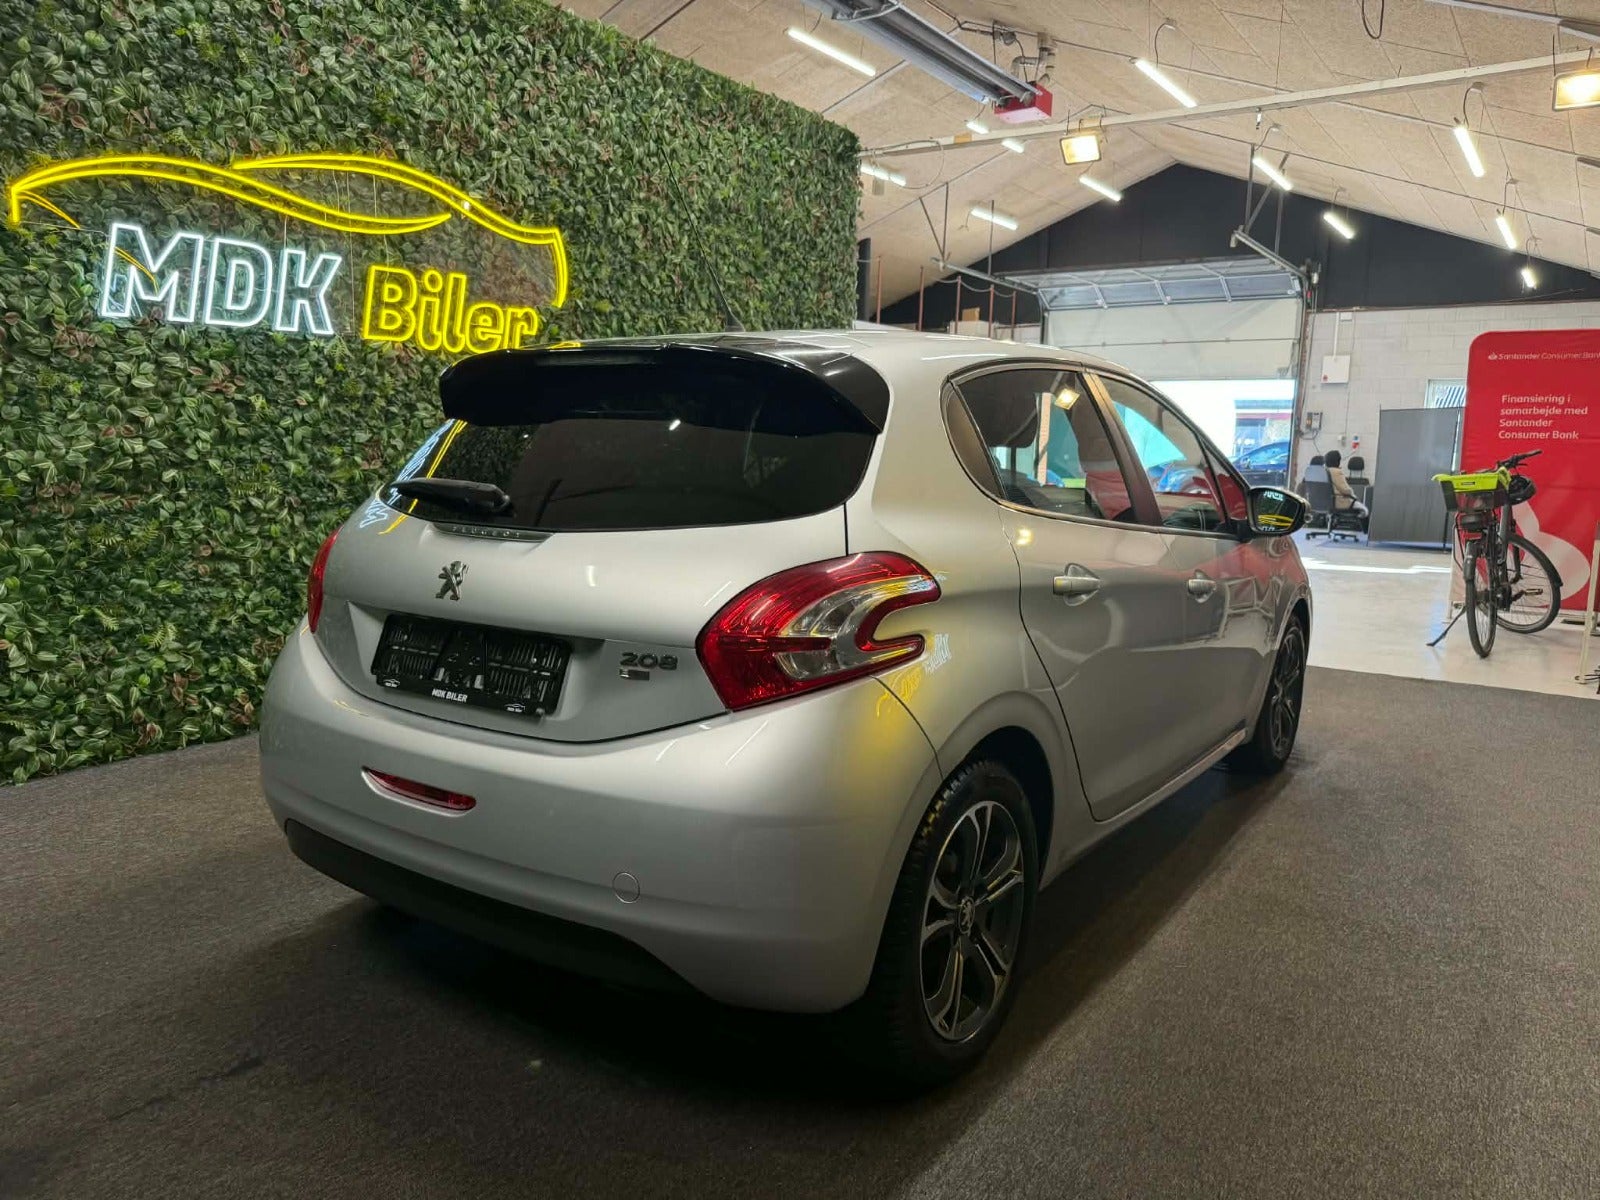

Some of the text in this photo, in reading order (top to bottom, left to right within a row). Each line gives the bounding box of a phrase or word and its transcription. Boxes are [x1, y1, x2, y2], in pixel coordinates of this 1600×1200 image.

[101, 223, 539, 355] MDK Biler
[1498, 352, 1540, 360] Santander
[1501, 394, 1571, 405] Finansiering i
[1500, 406, 1588, 417] samarbejde med
[1499, 419, 1553, 427] Santander
[1498, 430, 1579, 439] Consumer Bank
[620, 652, 678, 670] 208
[446, 691, 468, 703] BILER
